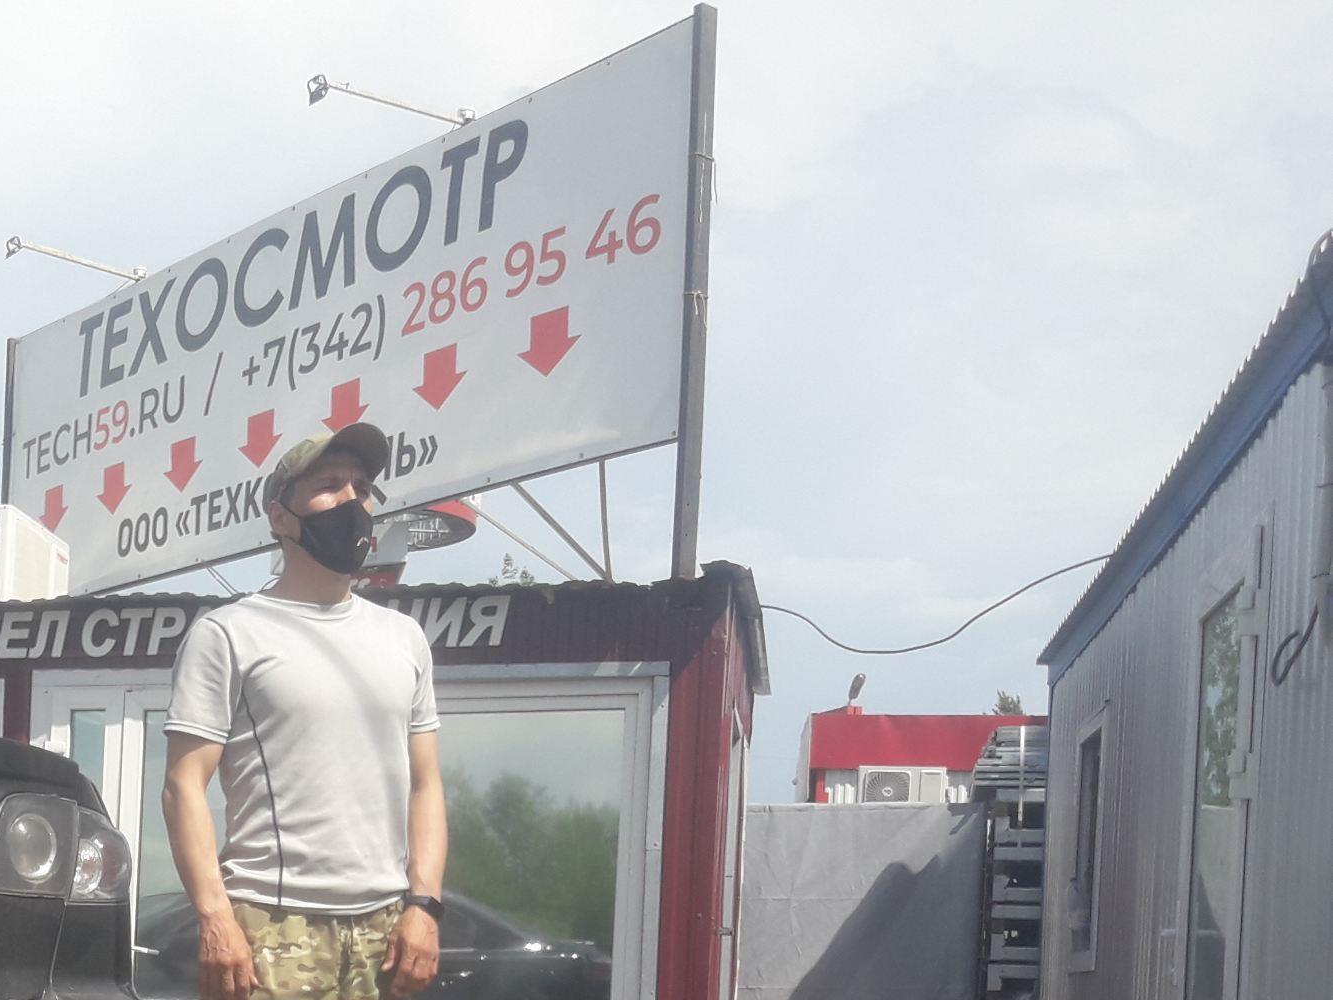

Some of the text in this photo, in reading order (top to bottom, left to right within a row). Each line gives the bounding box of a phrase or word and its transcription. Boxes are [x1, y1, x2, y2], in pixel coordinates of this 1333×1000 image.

[22, 374, 185, 479] TECH59.RU
[241, 294, 386, 390] +7(342)
[401, 256, 488, 337] 286
[504, 226, 566, 298] 95
[585, 193, 661, 265] 46
[79, 119, 529, 397] ТЕХОСМОТР
[118, 506, 168, 558] ООО
